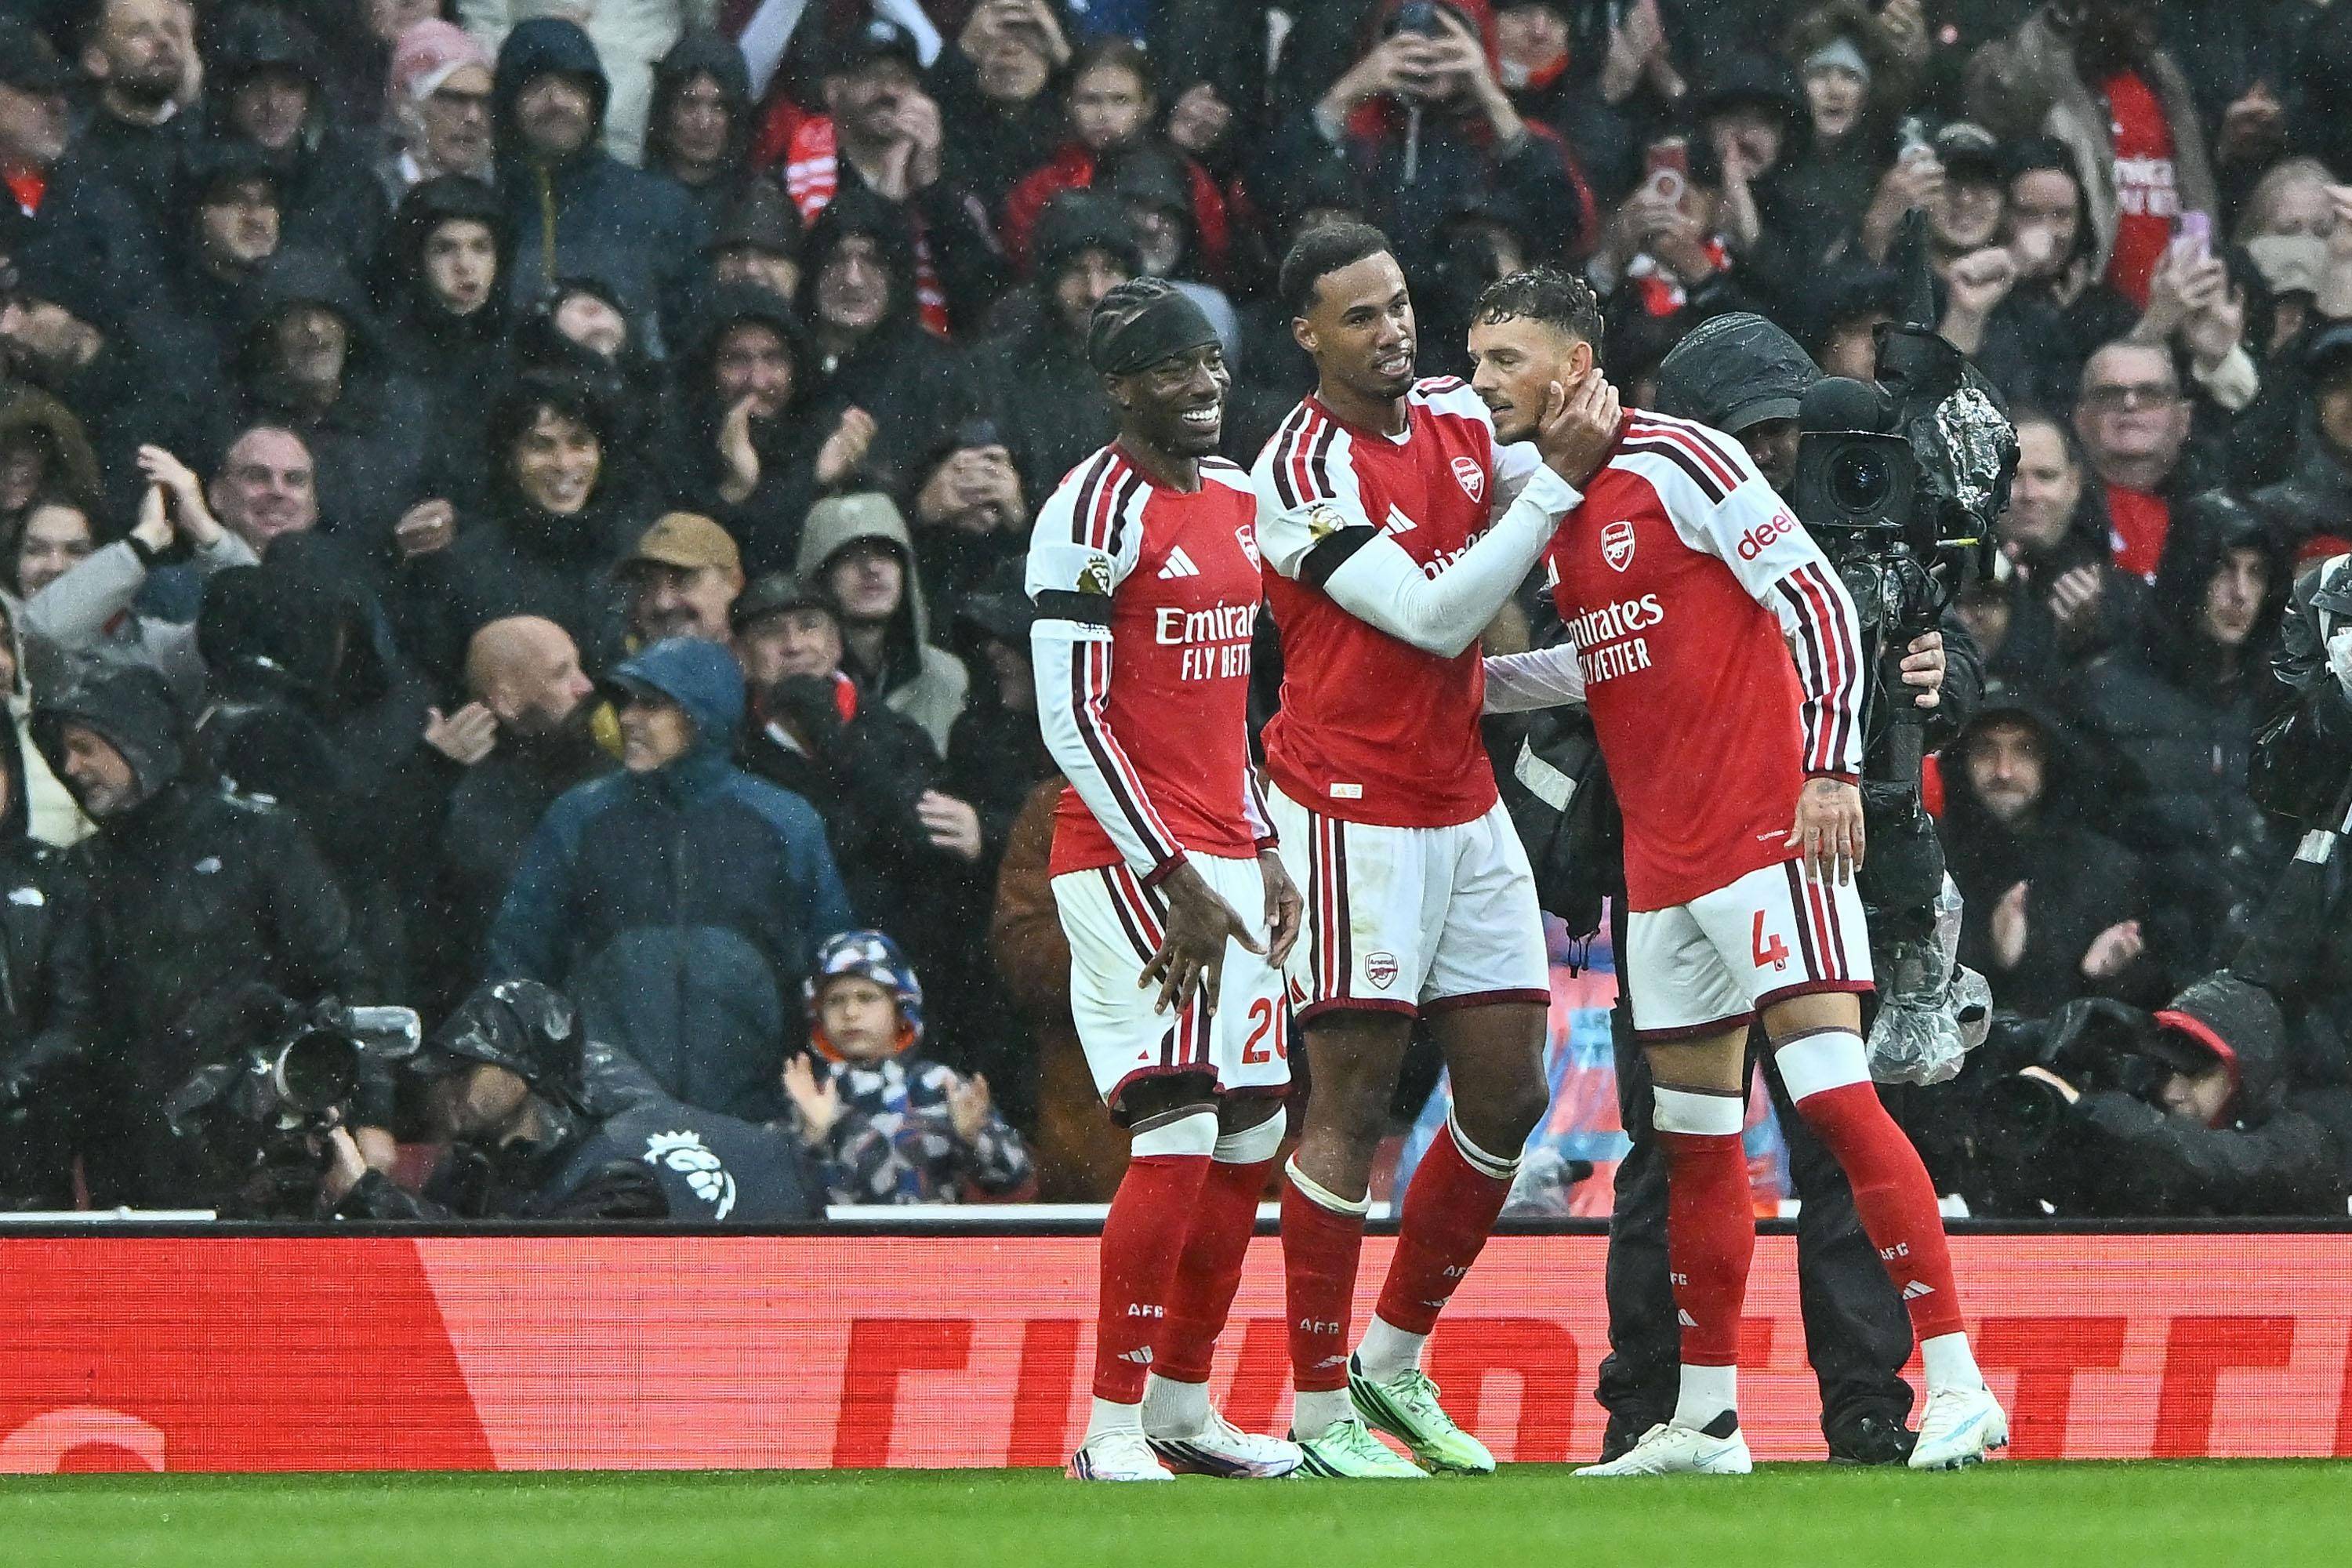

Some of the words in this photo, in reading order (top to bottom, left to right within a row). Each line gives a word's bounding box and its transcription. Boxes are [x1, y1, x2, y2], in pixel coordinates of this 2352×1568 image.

[1738, 506, 1798, 561] deel
[1156, 600, 1261, 644] Emirat
[1560, 593, 1664, 649] mirates
[1181, 647, 1215, 681] FLY
[1221, 643, 1250, 678] BETT
[1595, 637, 1652, 682] BETTER
[1753, 909, 1789, 971] 4
[1443, 1265, 1467, 1277] AF
[1879, 1242, 1909, 1260] AFC
[1670, 1271, 1687, 1285] FC
